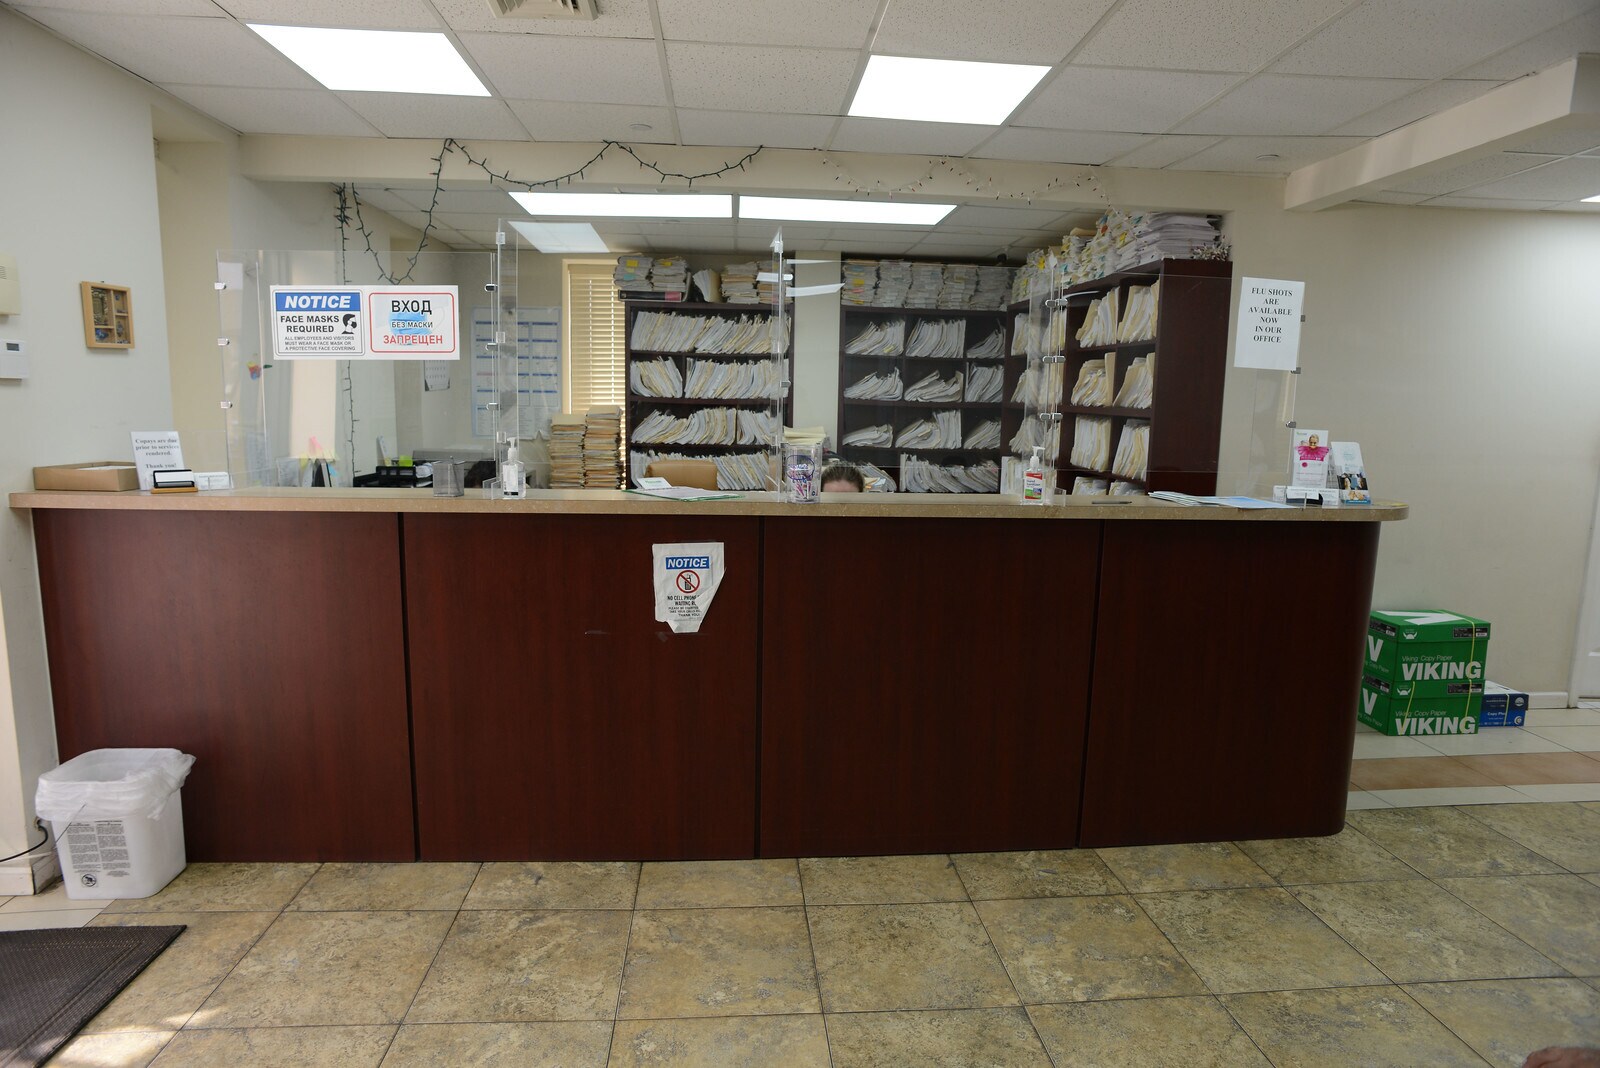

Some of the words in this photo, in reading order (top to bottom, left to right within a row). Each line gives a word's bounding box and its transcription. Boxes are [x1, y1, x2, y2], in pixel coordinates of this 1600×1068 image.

[1268, 288, 1293, 297] SHOTS
[284, 295, 351, 309] NOTICE
[391, 300, 432, 315] ВХОД
[1248, 307, 1292, 316] AVAILABLE
[280, 315, 304, 323] FACE
[306, 315, 340, 323] MASKS
[286, 325, 335, 333] REQUIRED
[383, 334, 443, 346] ЗАПРЕЩЕН
[1253, 335, 1282, 343] OFFICE
[667, 558, 708, 568] NOTICE
[1402, 661, 1482, 680] VIKING
[1395, 716, 1476, 736] VIKING
